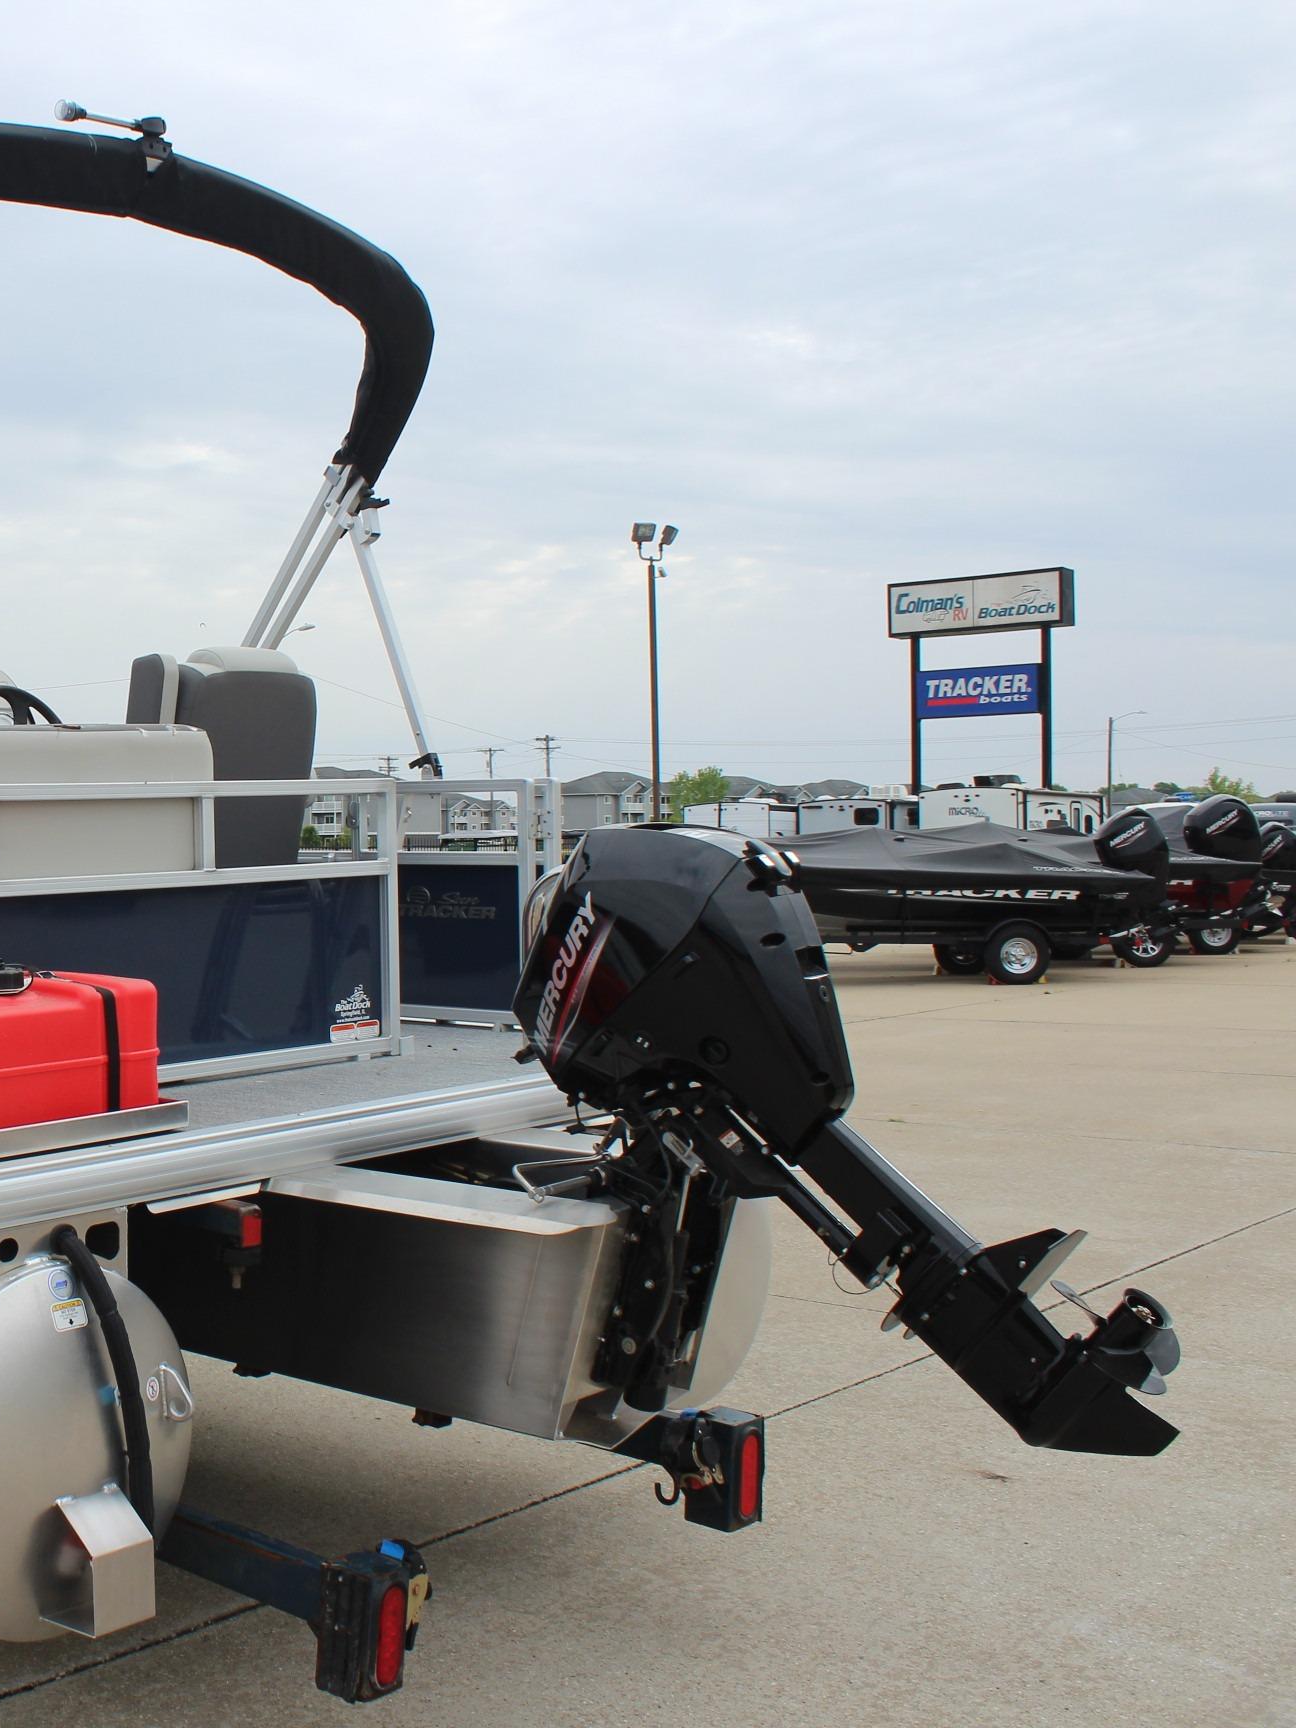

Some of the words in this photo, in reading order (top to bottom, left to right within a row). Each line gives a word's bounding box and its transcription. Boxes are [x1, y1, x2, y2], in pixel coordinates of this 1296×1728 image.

[895, 592, 964, 614] Colman's
[978, 606, 1015, 618] Boat
[1016, 602, 1056, 615] Dock
[952, 608, 968, 621] RV
[926, 674, 1030, 698] TRACKER
[979, 693, 1028, 704] boats
[1205, 808, 1238, 834] MERCURY
[1109, 821, 1145, 848] MERCURY
[400, 904, 497, 919] TRACKER
[533, 891, 596, 1055] MERCURY
